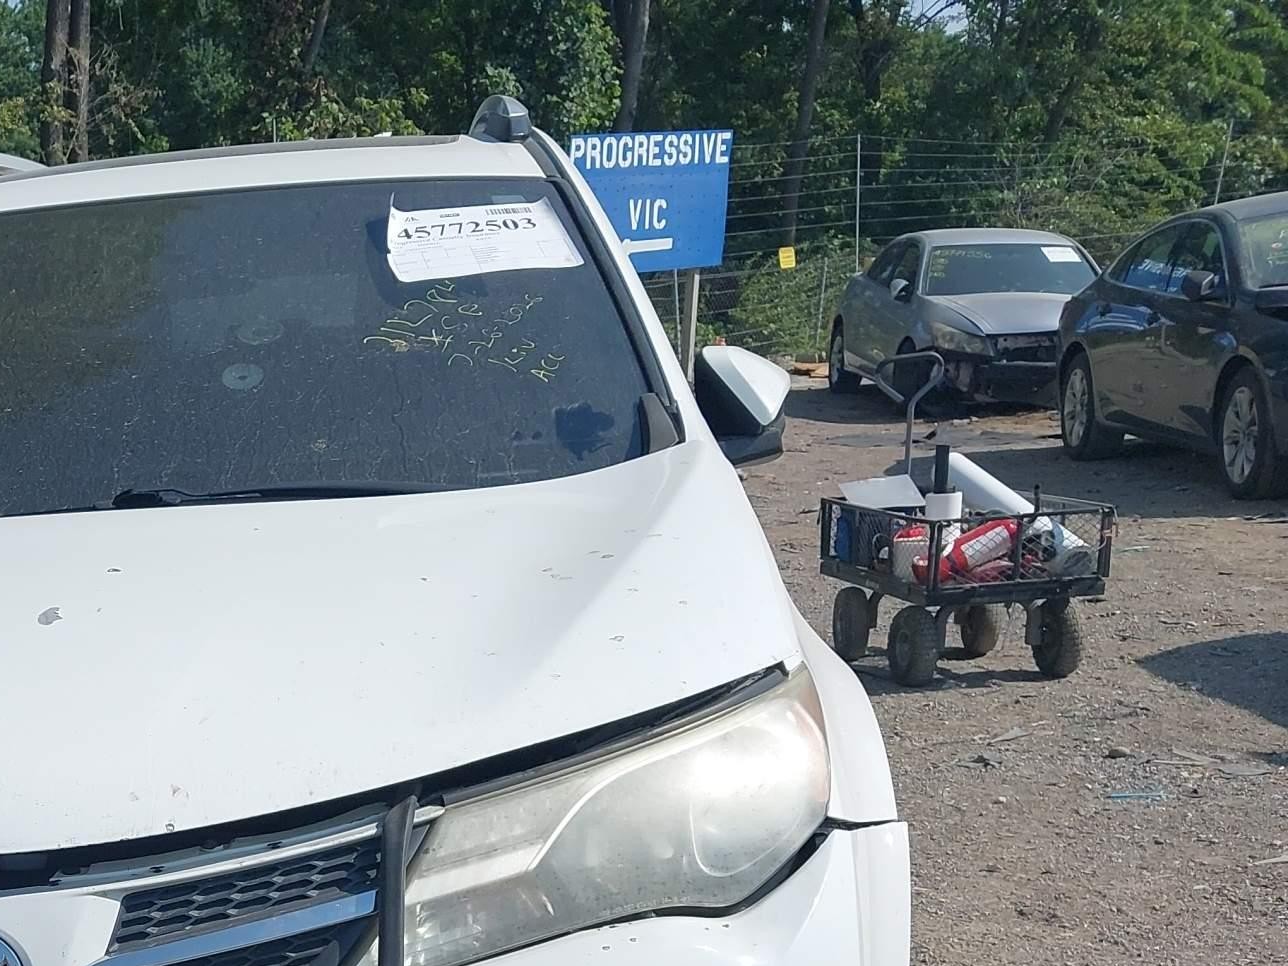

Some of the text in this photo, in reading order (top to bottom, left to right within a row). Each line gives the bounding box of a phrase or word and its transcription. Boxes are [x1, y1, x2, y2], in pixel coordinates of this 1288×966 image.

[571, 132, 731, 170] PROGRESSIVE
[397, 217, 537, 240] 45772503
[629, 198, 668, 231] VIC
